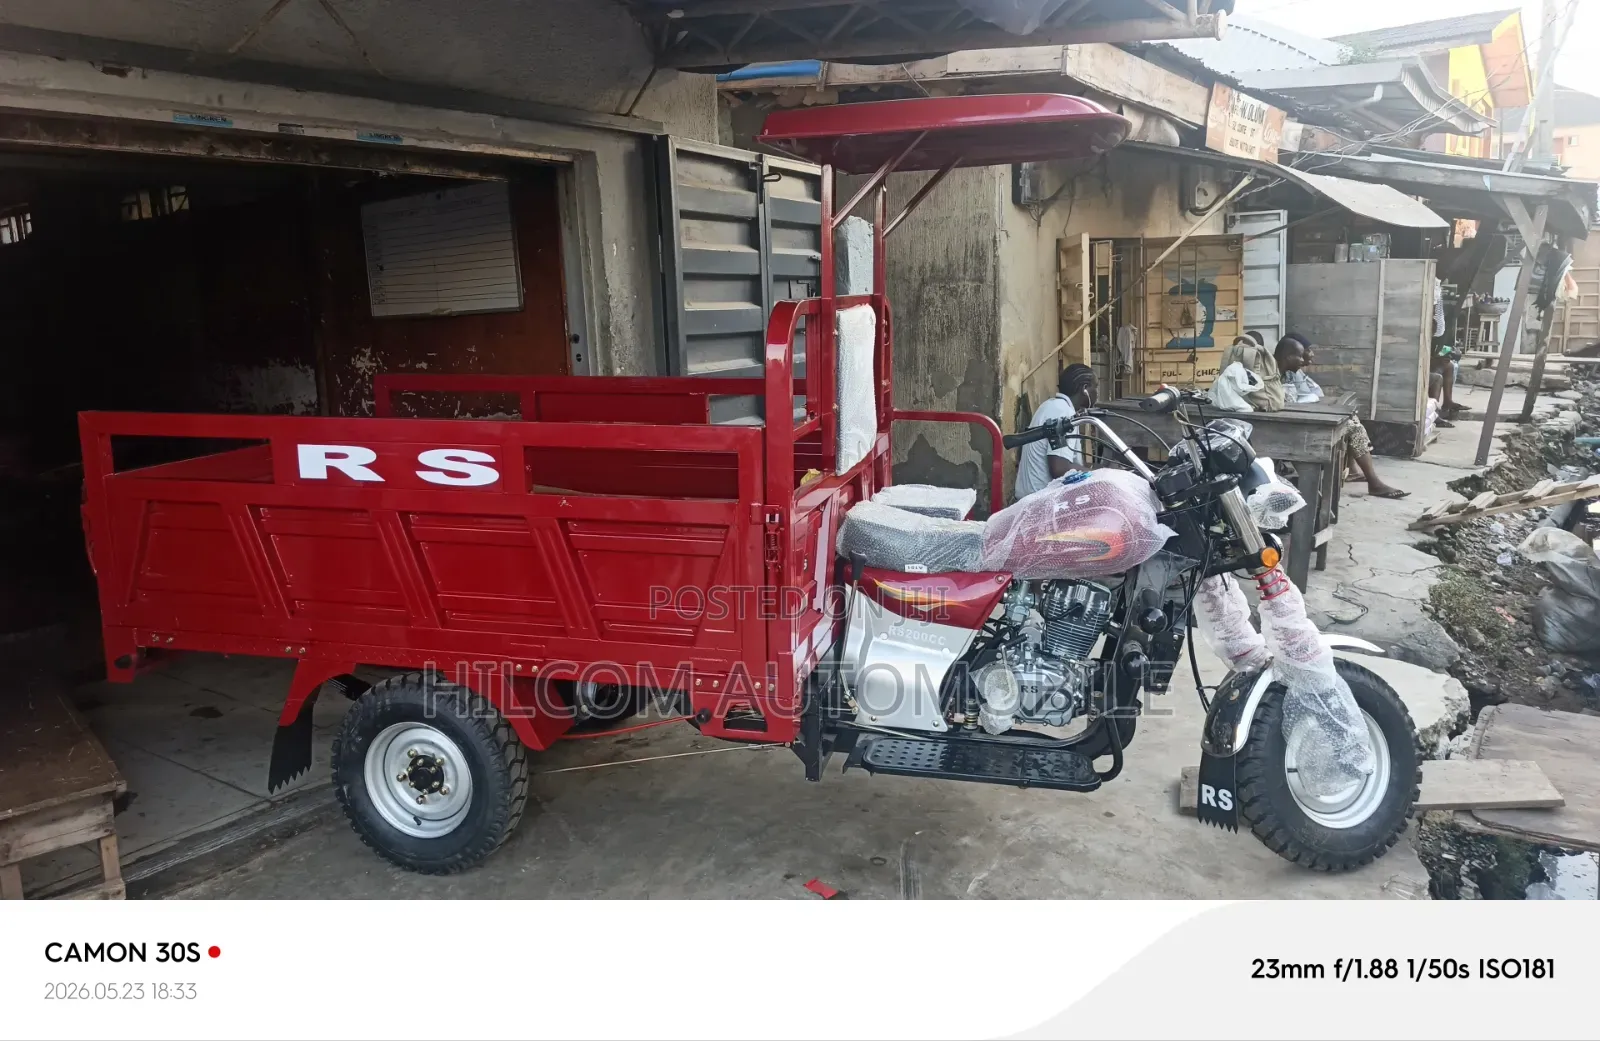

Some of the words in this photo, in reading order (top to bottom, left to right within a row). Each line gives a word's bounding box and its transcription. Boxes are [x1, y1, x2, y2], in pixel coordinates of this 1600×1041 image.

[888, 624, 946, 646] RS200CC
[1020, 684, 1039, 694] RS
[1201, 783, 1234, 811] RS
